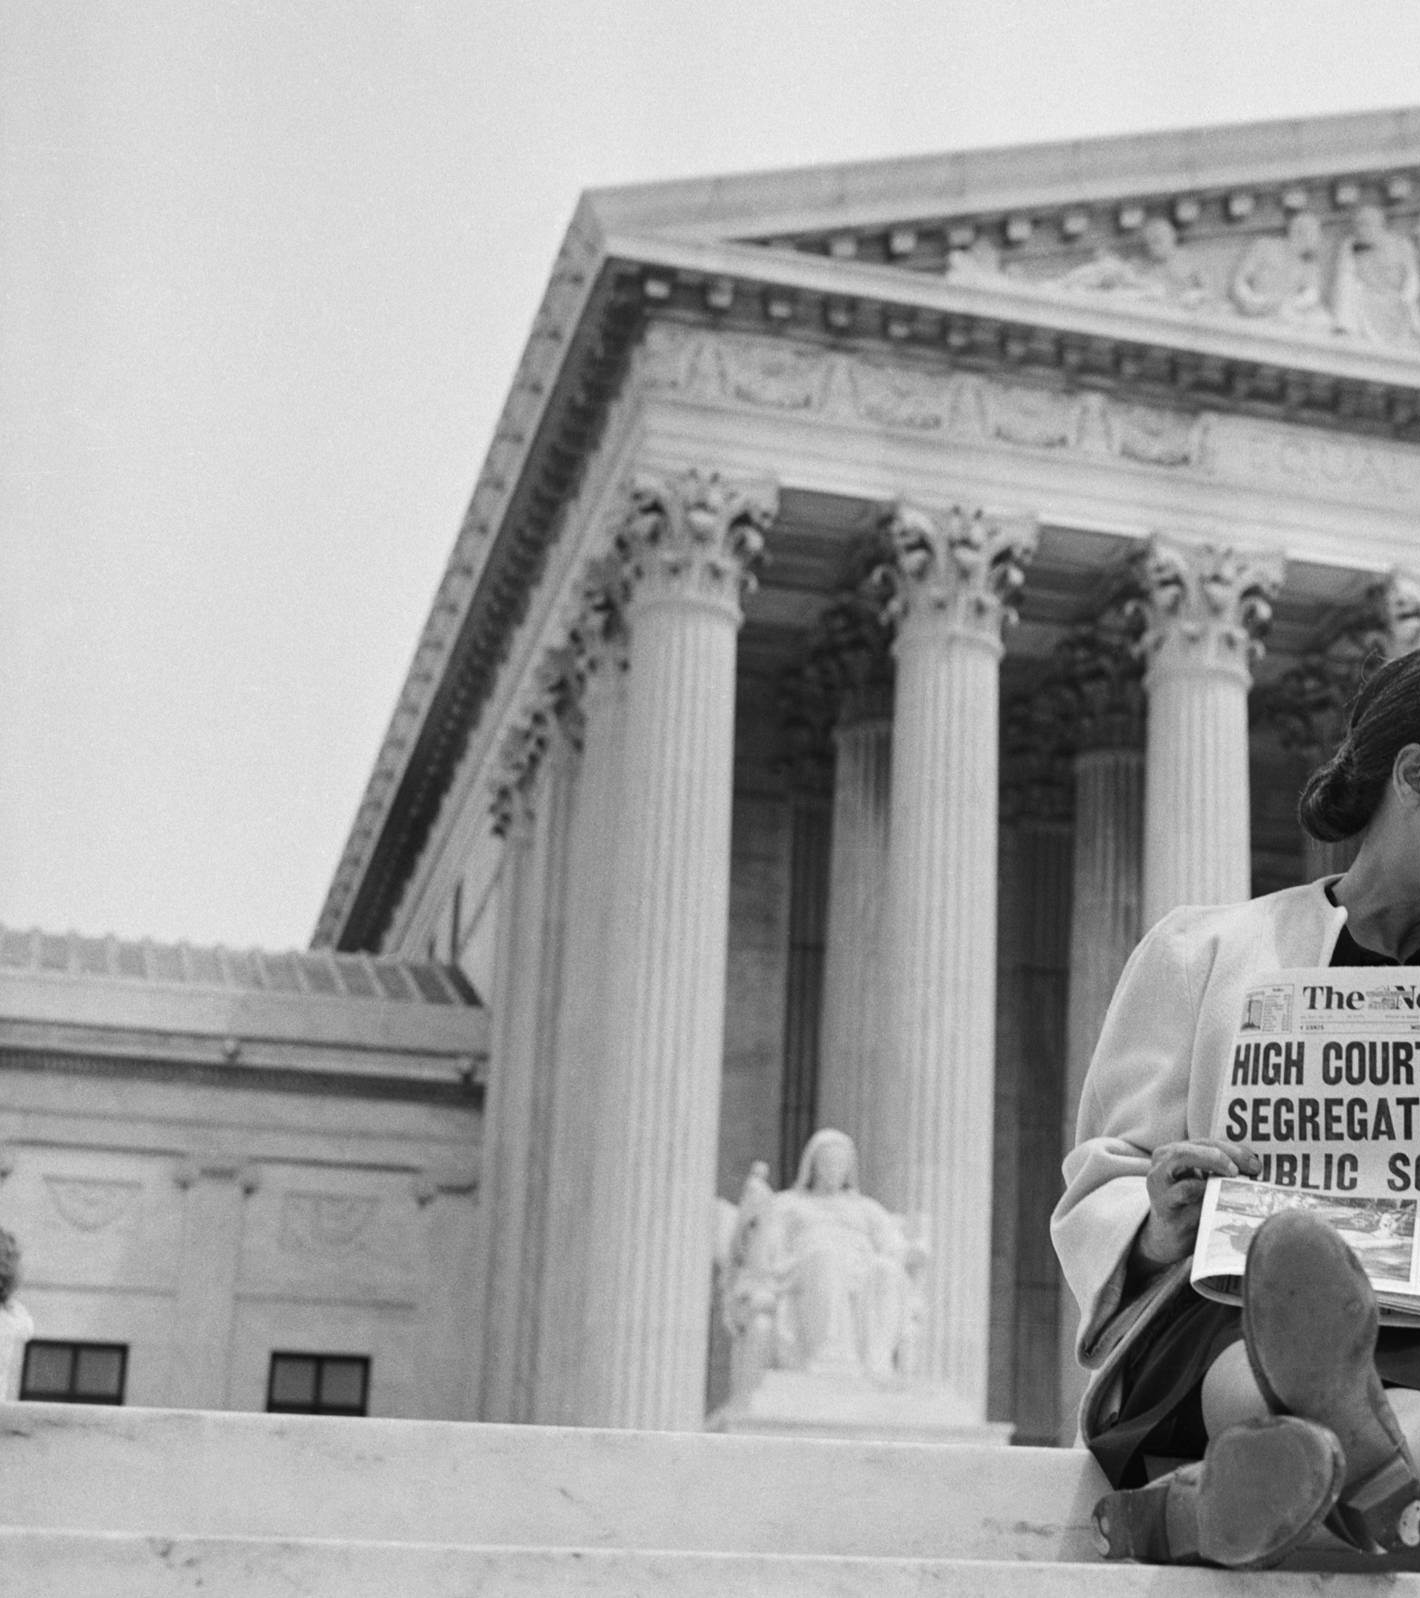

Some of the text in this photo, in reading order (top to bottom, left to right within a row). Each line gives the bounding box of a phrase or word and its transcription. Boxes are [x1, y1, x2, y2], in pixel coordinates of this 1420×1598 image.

[1303, 986, 1365, 1010] The
[1231, 1041, 1305, 1086] HIGH
[1251, 1153, 1359, 1191] BLIC
